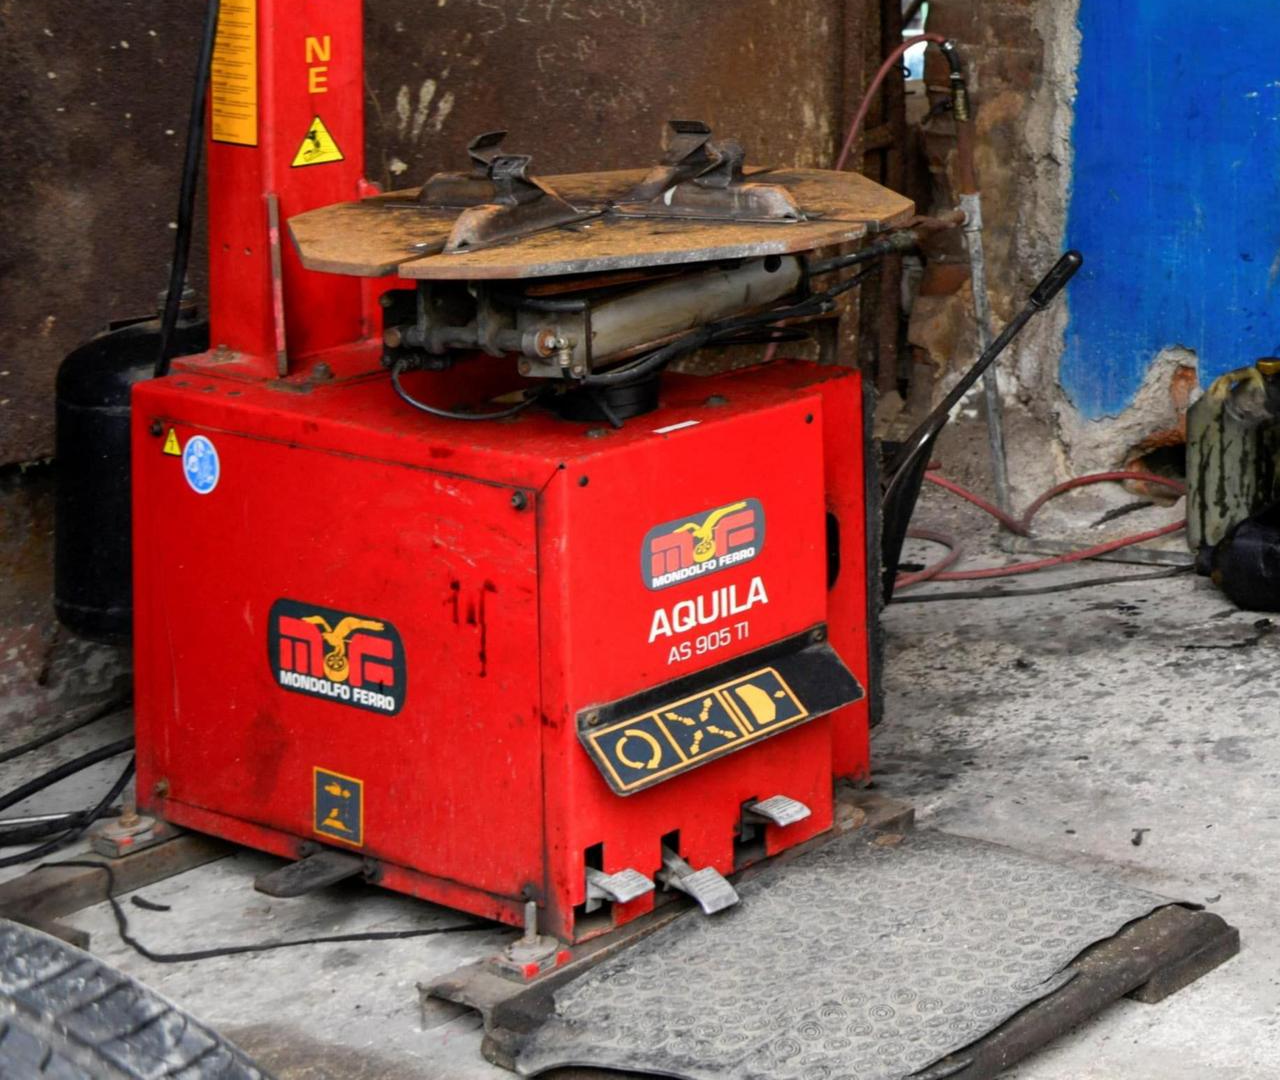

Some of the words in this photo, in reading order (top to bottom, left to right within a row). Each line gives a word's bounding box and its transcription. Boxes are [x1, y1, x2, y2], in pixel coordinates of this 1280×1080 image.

[652, 559, 716, 589] MONDOLFO
[719, 547, 755, 567] FERRO
[647, 575, 769, 644] AQUILA
[667, 641, 692, 665] AS
[695, 627, 732, 655] 905
[280, 670, 350, 700] MONDOLFO
[353, 688, 396, 711] FERRO
